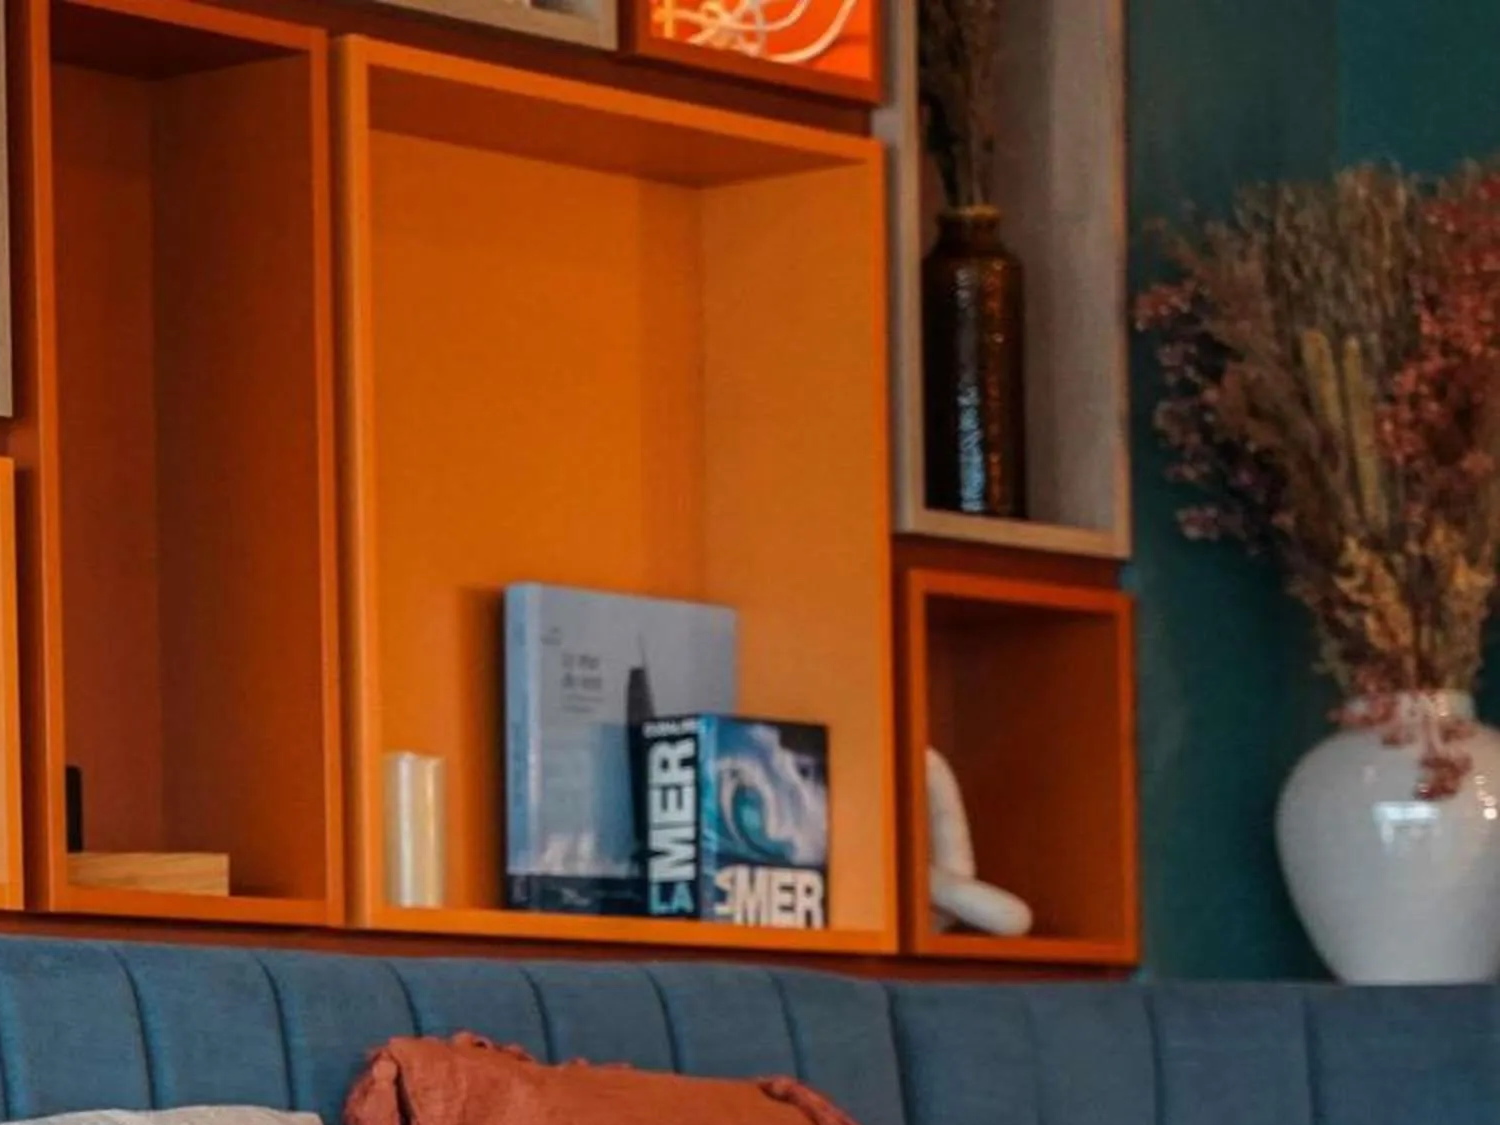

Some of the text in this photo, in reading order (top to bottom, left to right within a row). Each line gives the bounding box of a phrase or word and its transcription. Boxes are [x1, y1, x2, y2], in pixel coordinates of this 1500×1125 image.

[648, 737, 697, 882] MER
[650, 882, 695, 914] LA
[733, 865, 824, 929] MER
